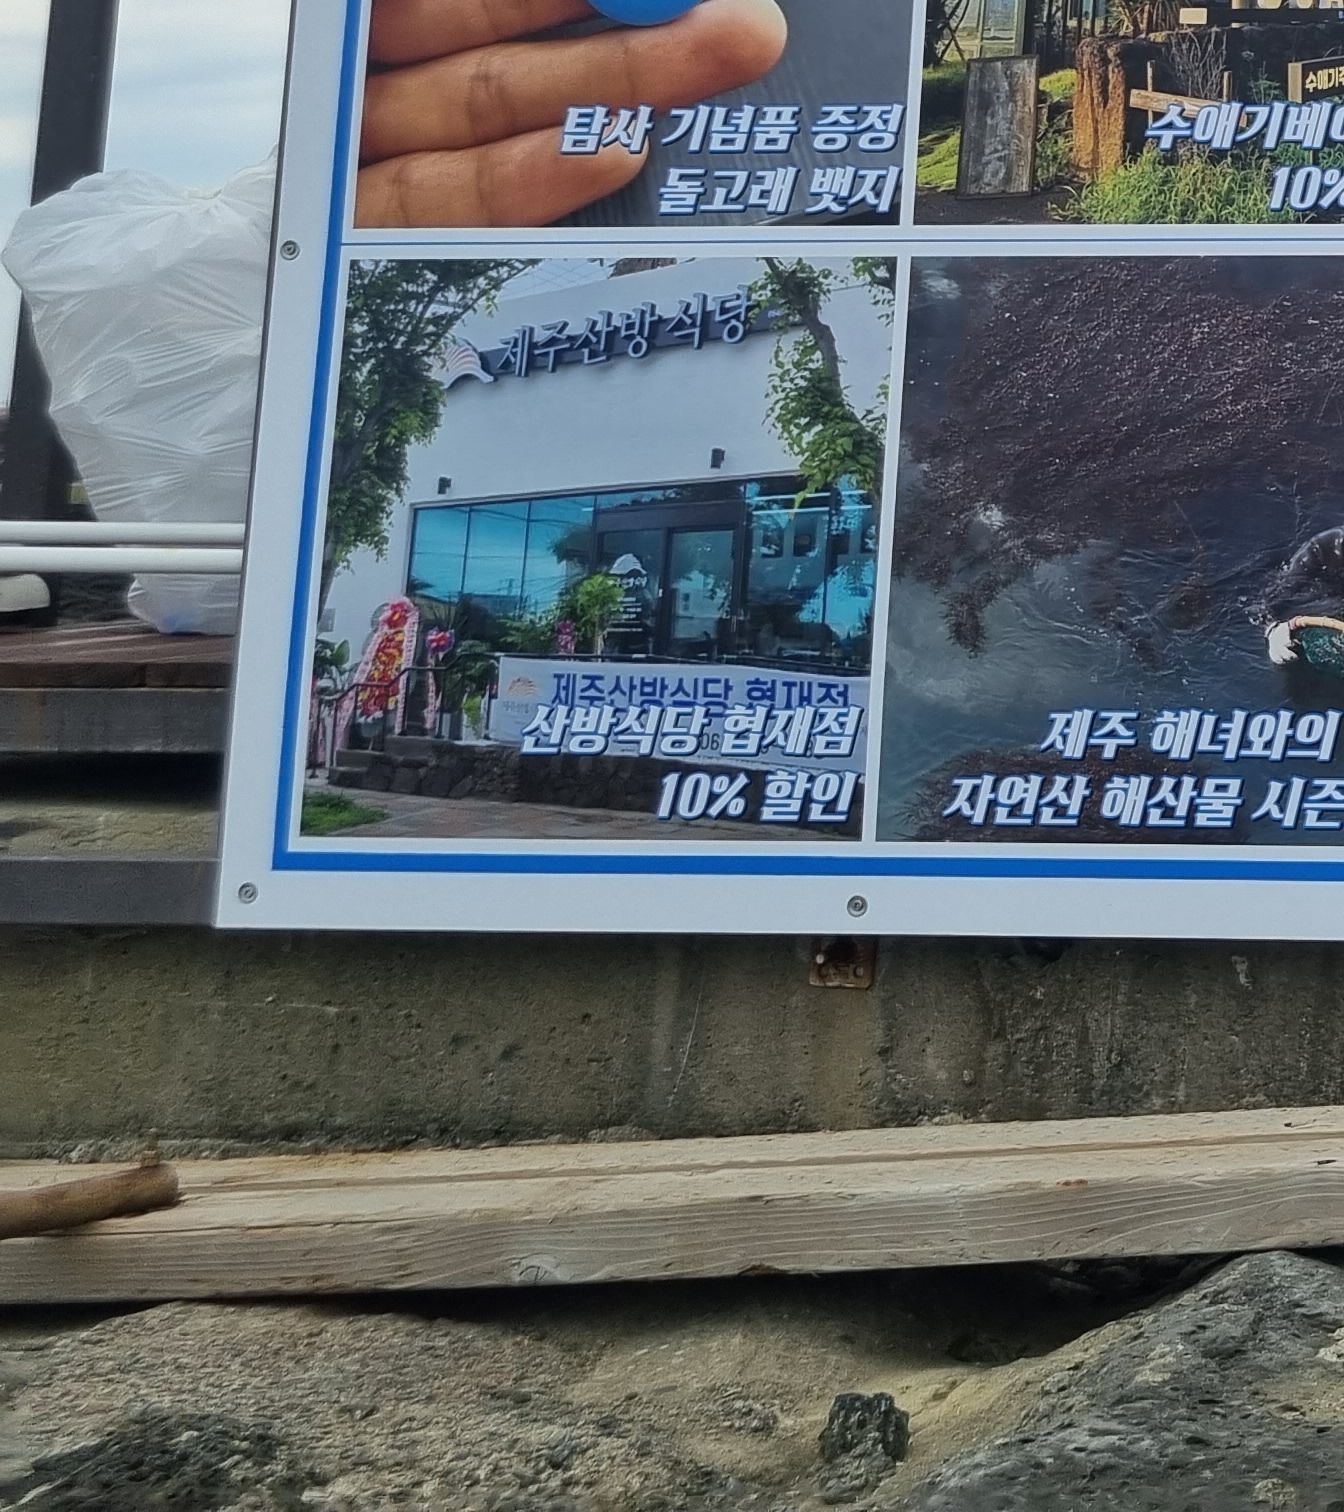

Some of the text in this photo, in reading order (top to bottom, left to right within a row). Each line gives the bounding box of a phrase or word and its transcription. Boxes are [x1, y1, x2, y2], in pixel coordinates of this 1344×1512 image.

[559, 102, 905, 155] 탐사 기념품 증정
[658, 165, 903, 216] 돌고래 뱃지
[497, 283, 753, 378] 제주산방식당
[520, 703, 712, 758] 산방식당
[720, 703, 863, 758] 협재점
[1040, 708, 1138, 760] 제주
[1151, 709, 1341, 763] 해녀와의
[657, 769, 864, 823] 10% 할인
[942, 772, 1090, 827] 자연산
[1102, 773, 1243, 829] 해산물
